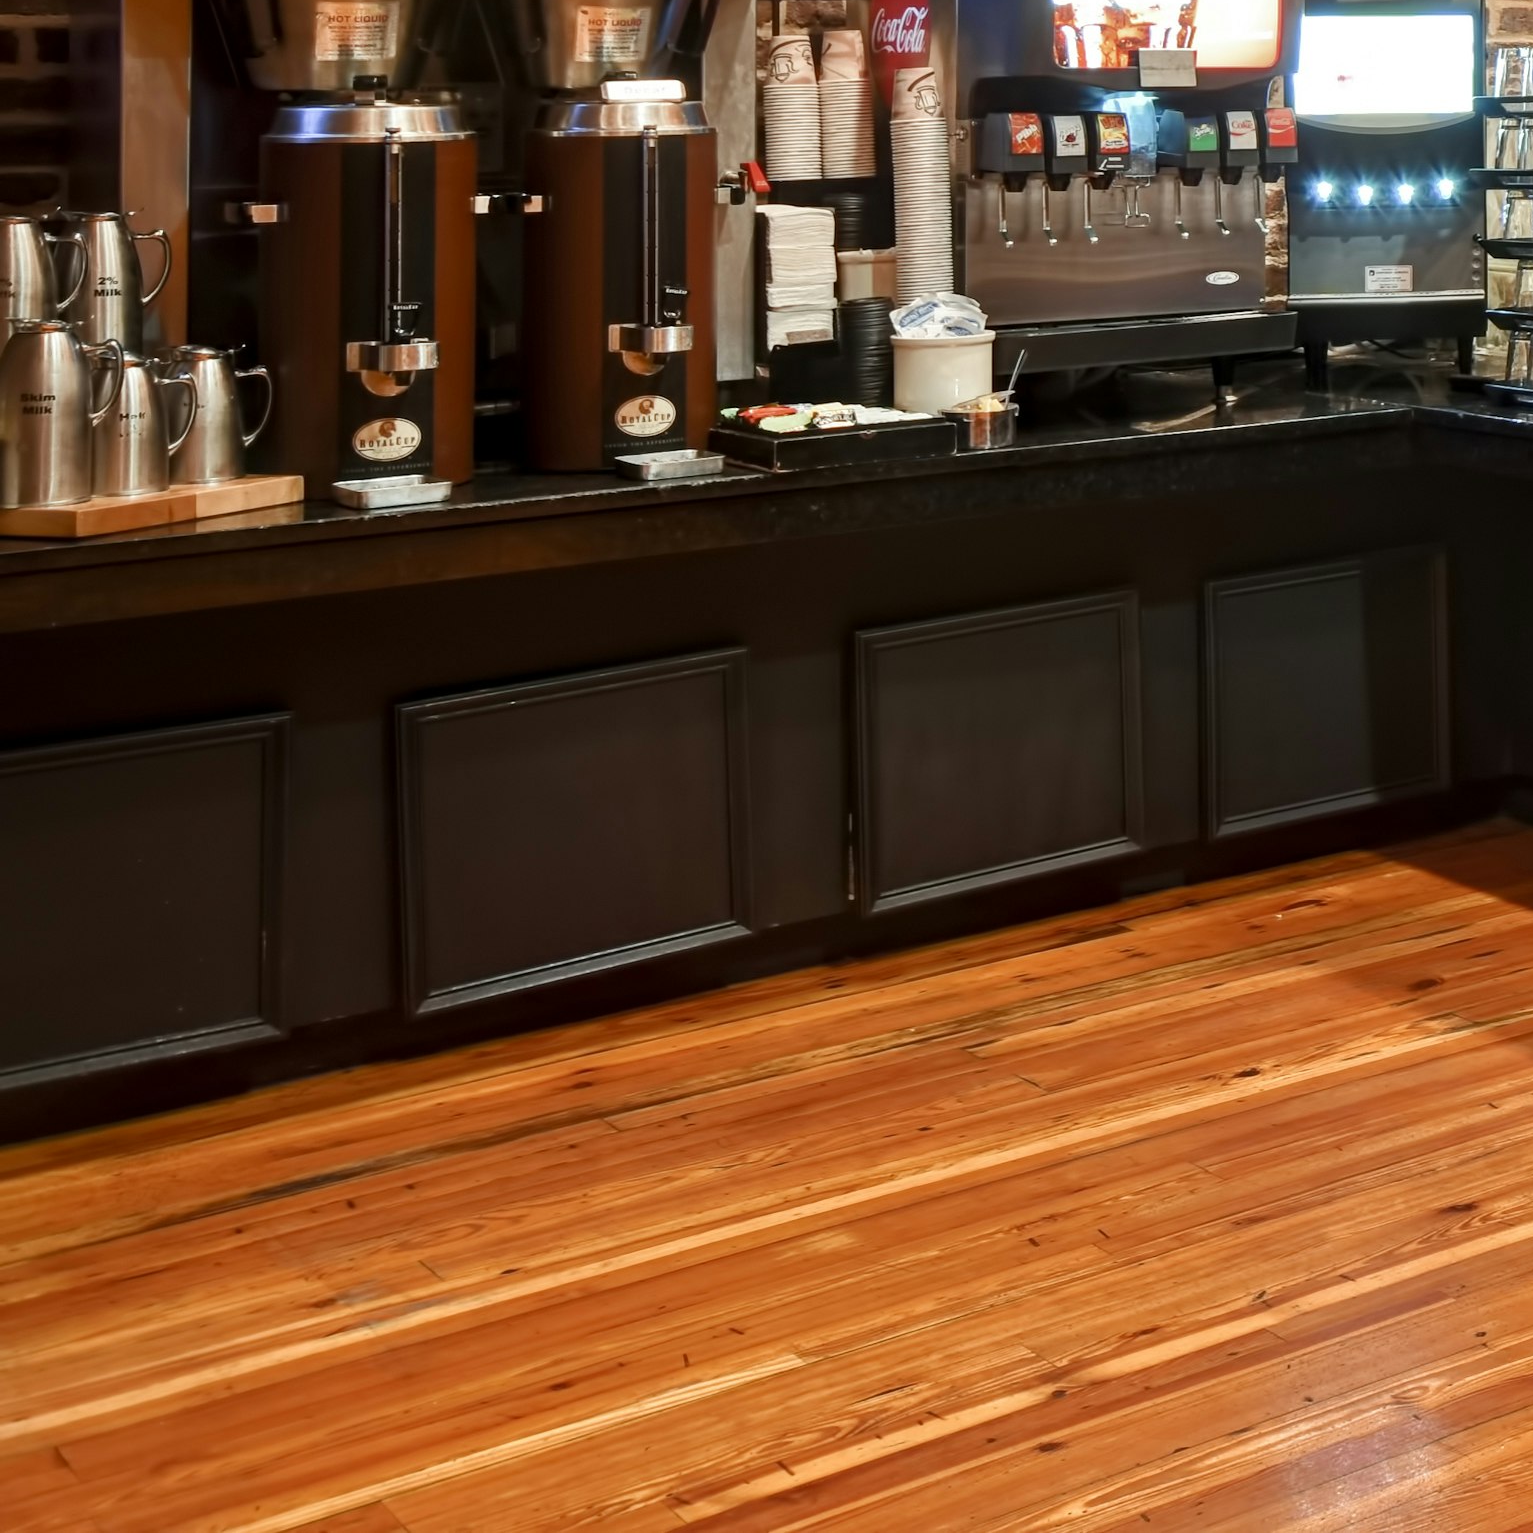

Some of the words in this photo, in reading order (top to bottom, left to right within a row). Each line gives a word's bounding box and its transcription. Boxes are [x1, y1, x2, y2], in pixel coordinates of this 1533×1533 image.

[328, 15, 352, 23] HOT
[588, 18, 607, 26] HOT
[611, 18, 642, 27] LIQUID
[97, 277, 119, 286] 2%
[94, 288, 123, 298] Milk
[20, 393, 56, 403] Skim
[22, 405, 53, 415] Milk
